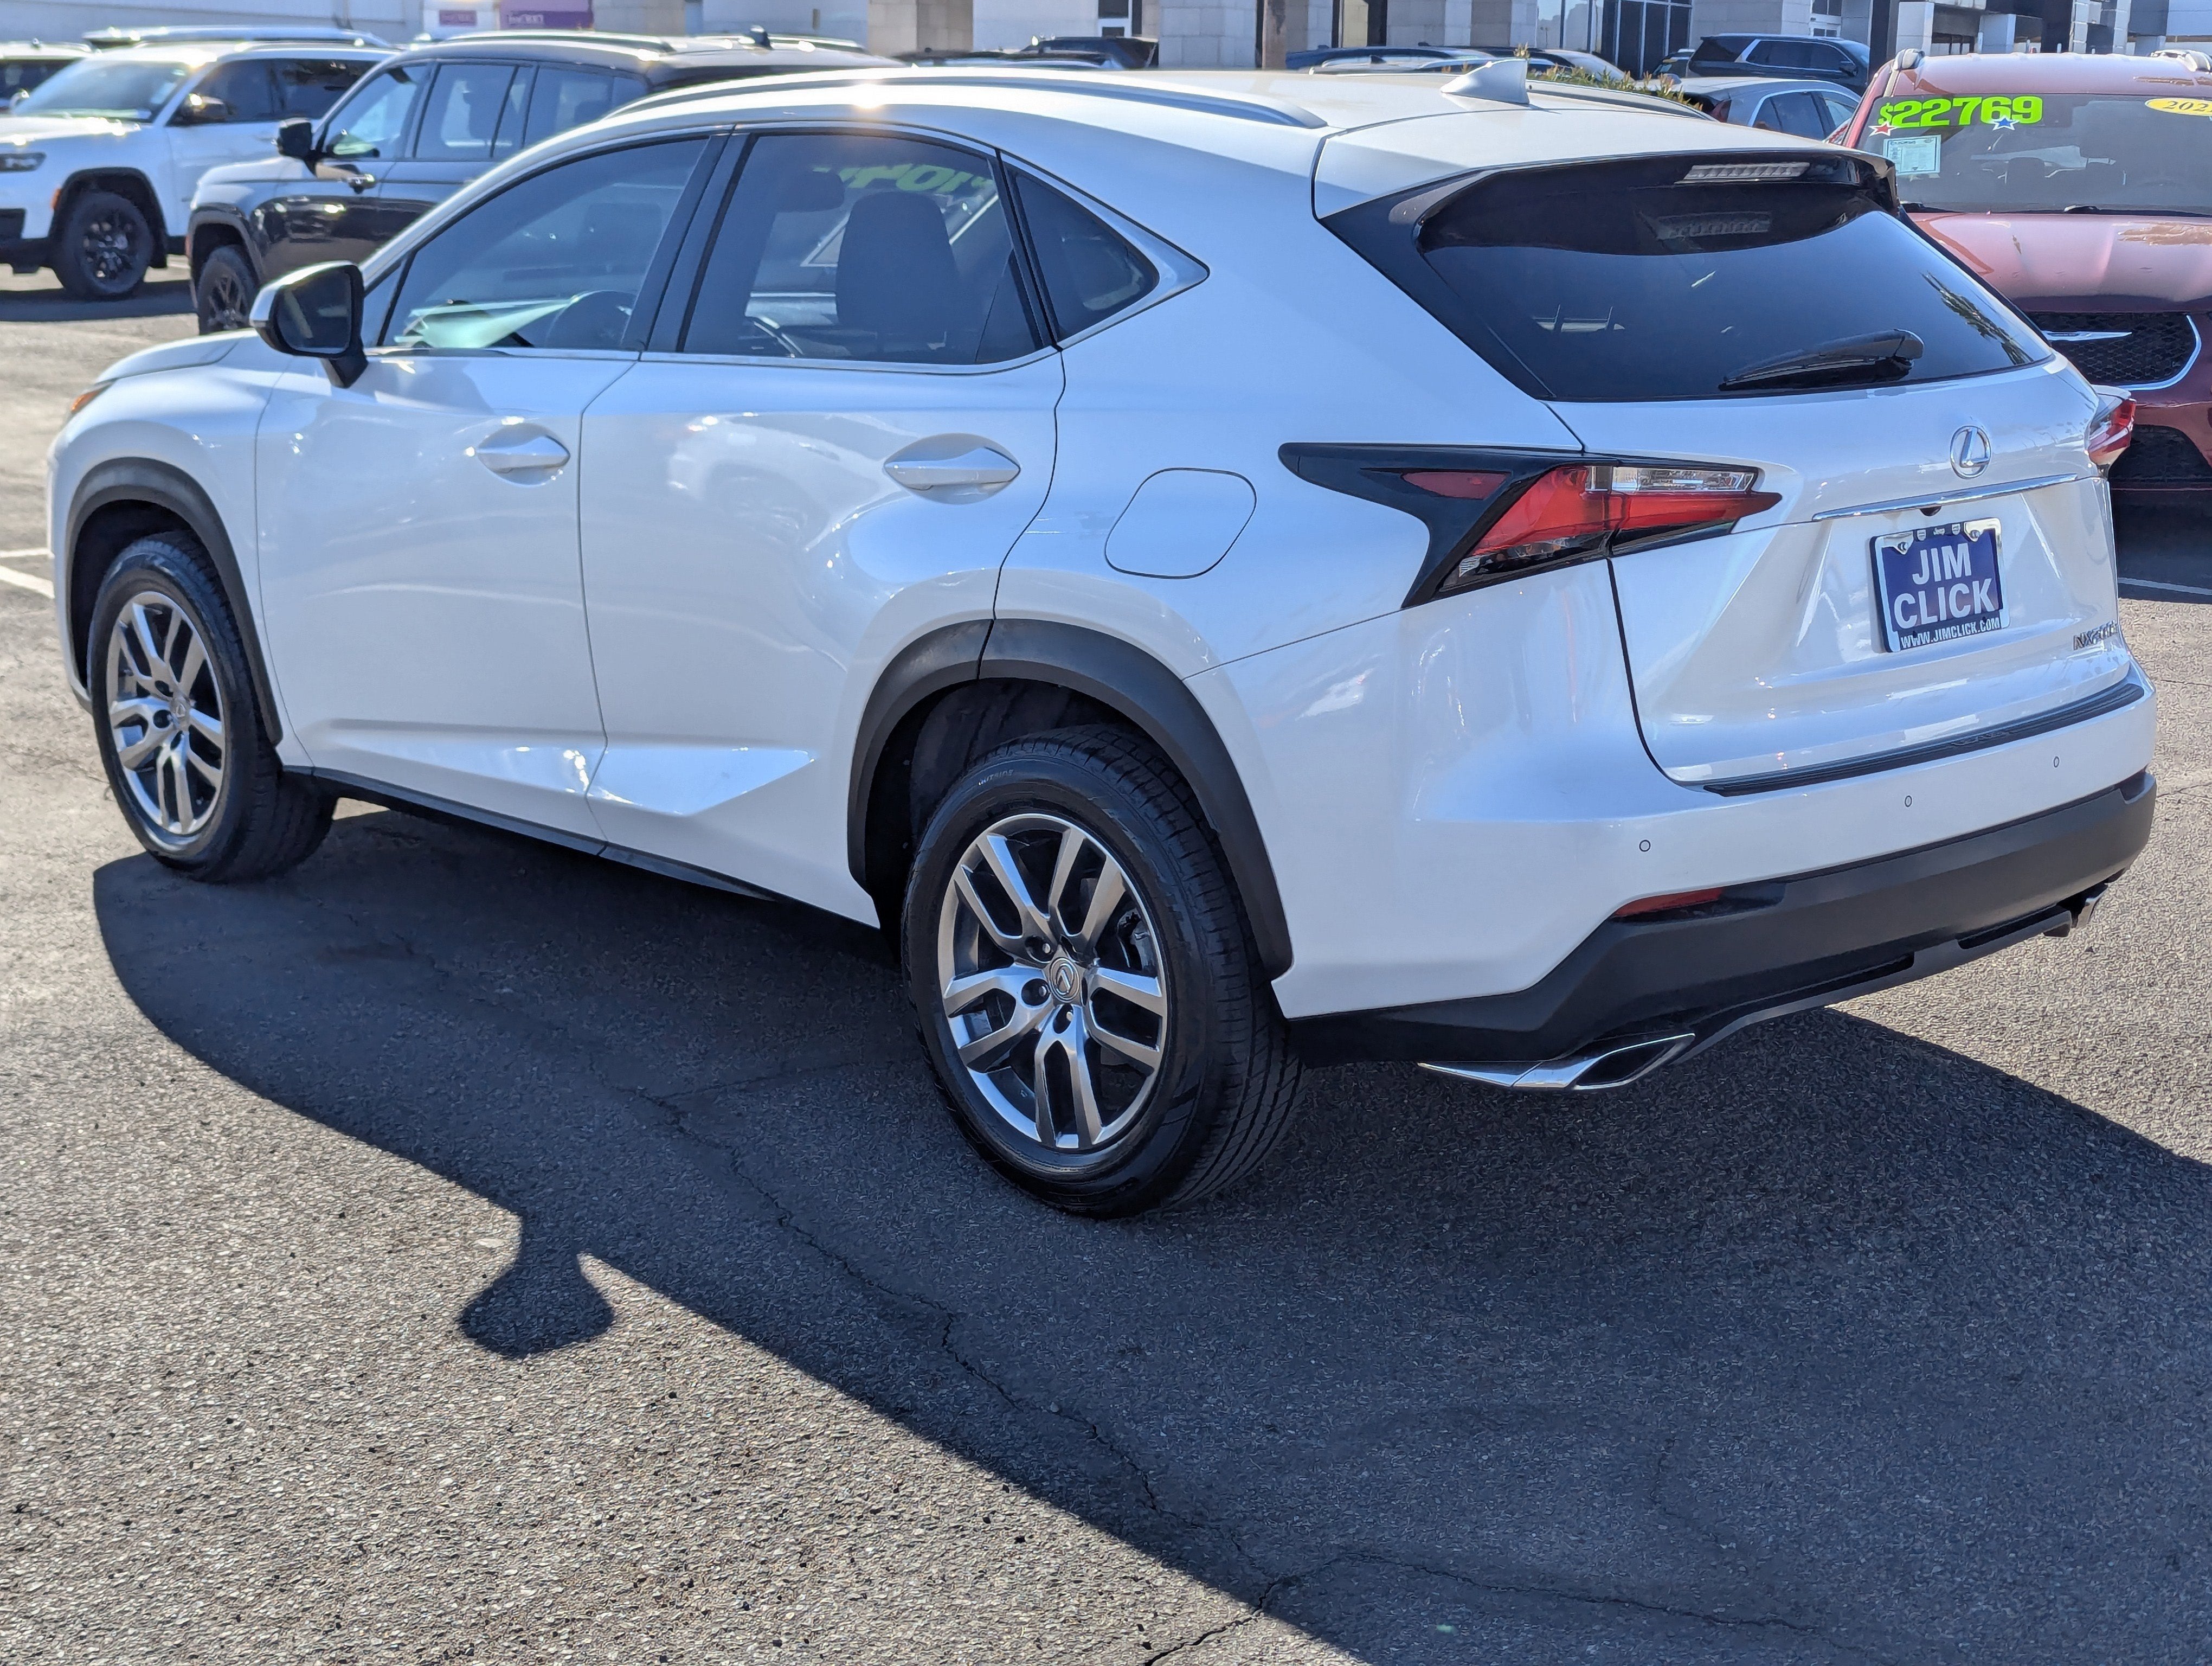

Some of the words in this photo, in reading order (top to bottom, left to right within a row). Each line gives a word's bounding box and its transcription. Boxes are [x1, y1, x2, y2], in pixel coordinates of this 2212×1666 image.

[1878, 96, 2043, 127] $22769
[2162, 100, 2212, 113] 202
[1912, 543, 1972, 585] JIM
[1894, 578, 1996, 629] CLICK
[1900, 617, 2000, 649] WWW.JIMCLICK.COM
